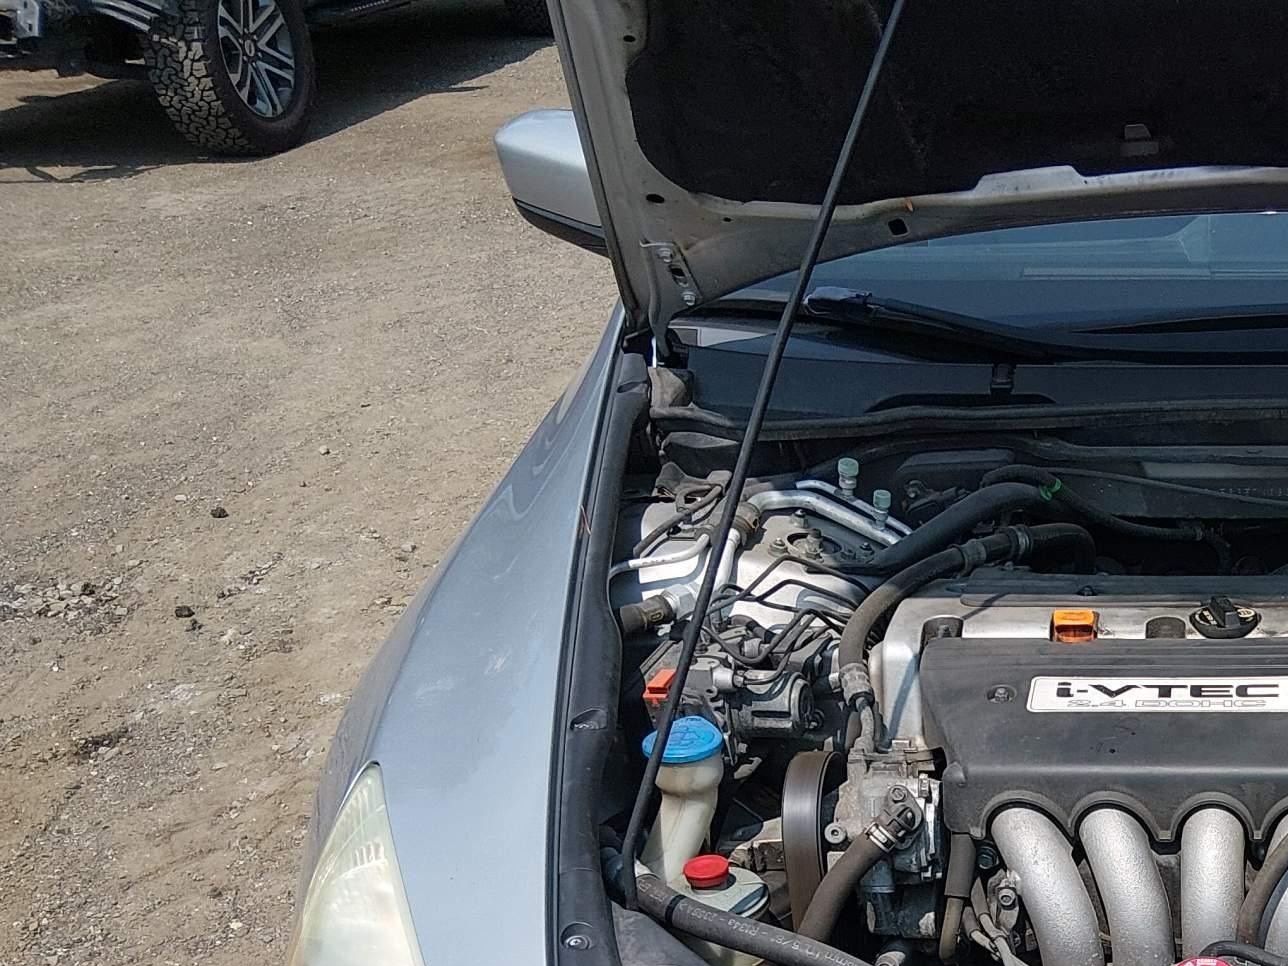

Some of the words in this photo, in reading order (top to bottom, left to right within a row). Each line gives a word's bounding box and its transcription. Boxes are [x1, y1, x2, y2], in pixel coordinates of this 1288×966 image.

[1056, 681, 1279, 698] i-VTEC
[1067, 699, 1126, 708] 2.4
[1135, 699, 1267, 708] DOHC
[726, 919, 760, 937] R134a
